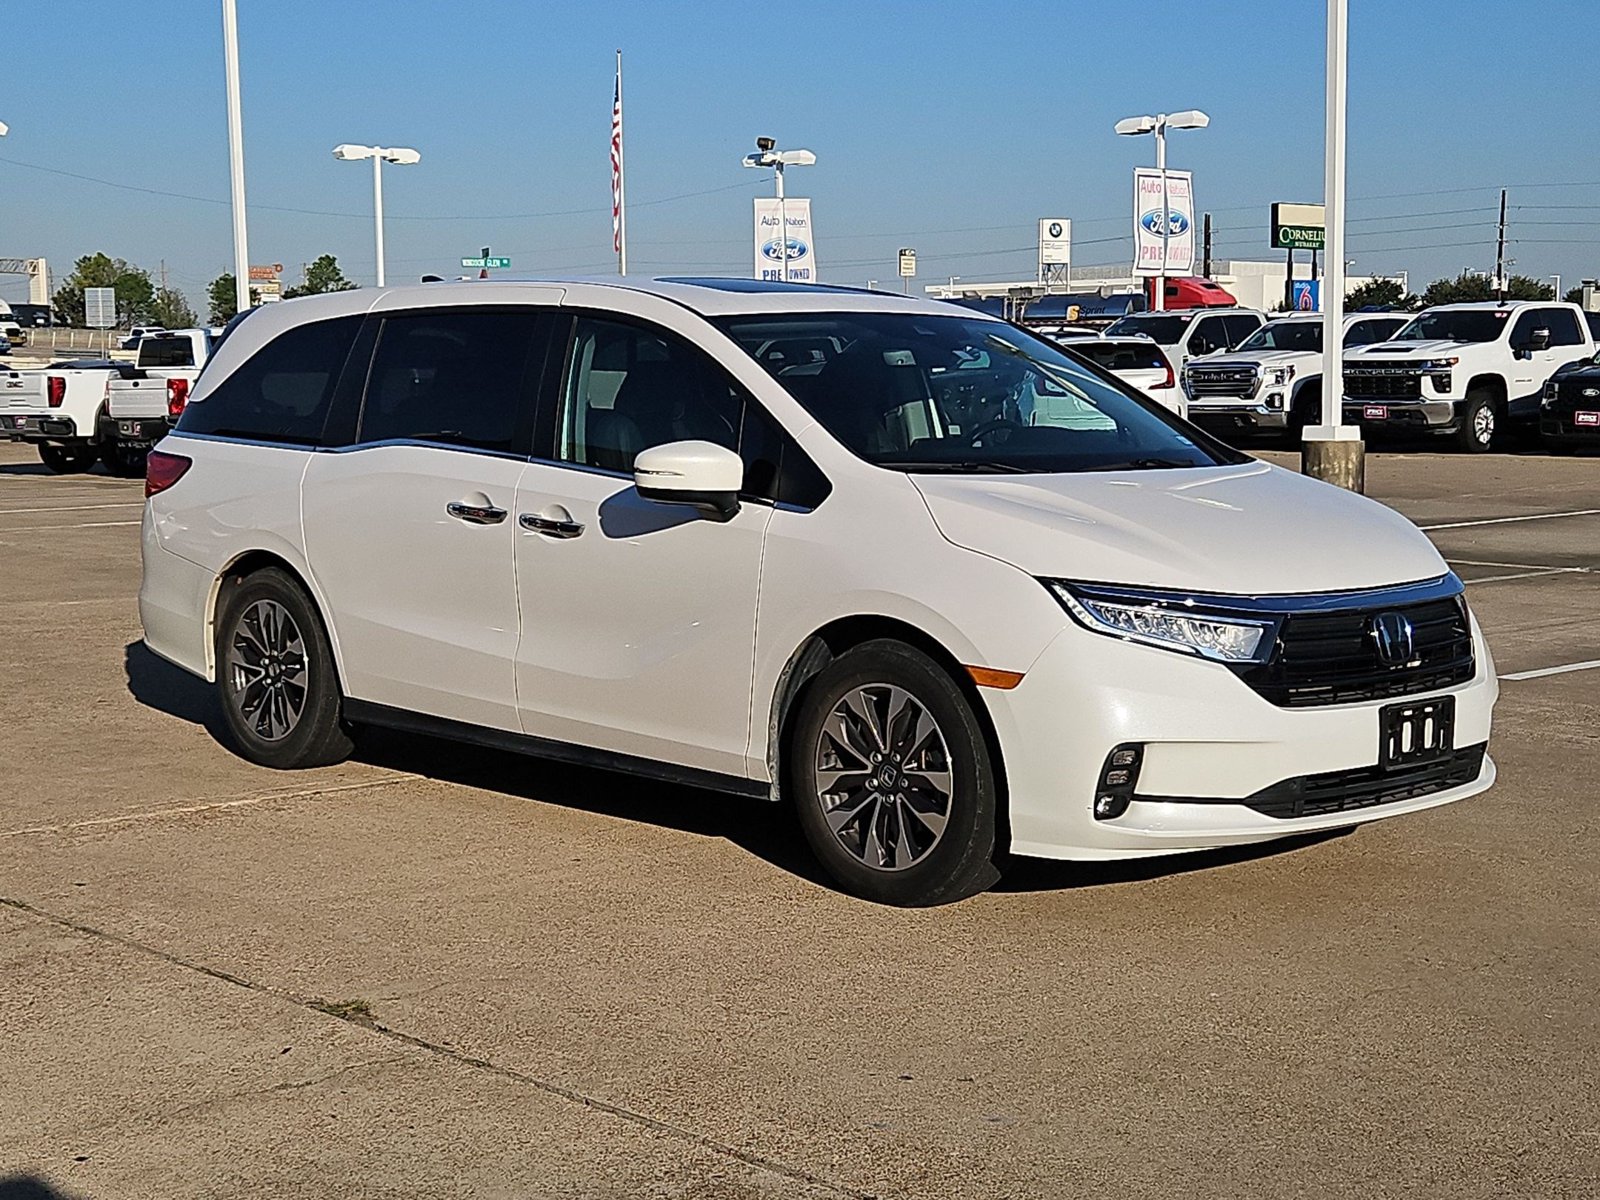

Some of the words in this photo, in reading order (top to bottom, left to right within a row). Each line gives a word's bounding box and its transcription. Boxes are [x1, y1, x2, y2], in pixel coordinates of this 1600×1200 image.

[1141, 180, 1162, 194] Auto
[761, 216, 780, 226] Auto
[1142, 246, 1163, 260] PRE
[763, 270, 782, 281] PRE
